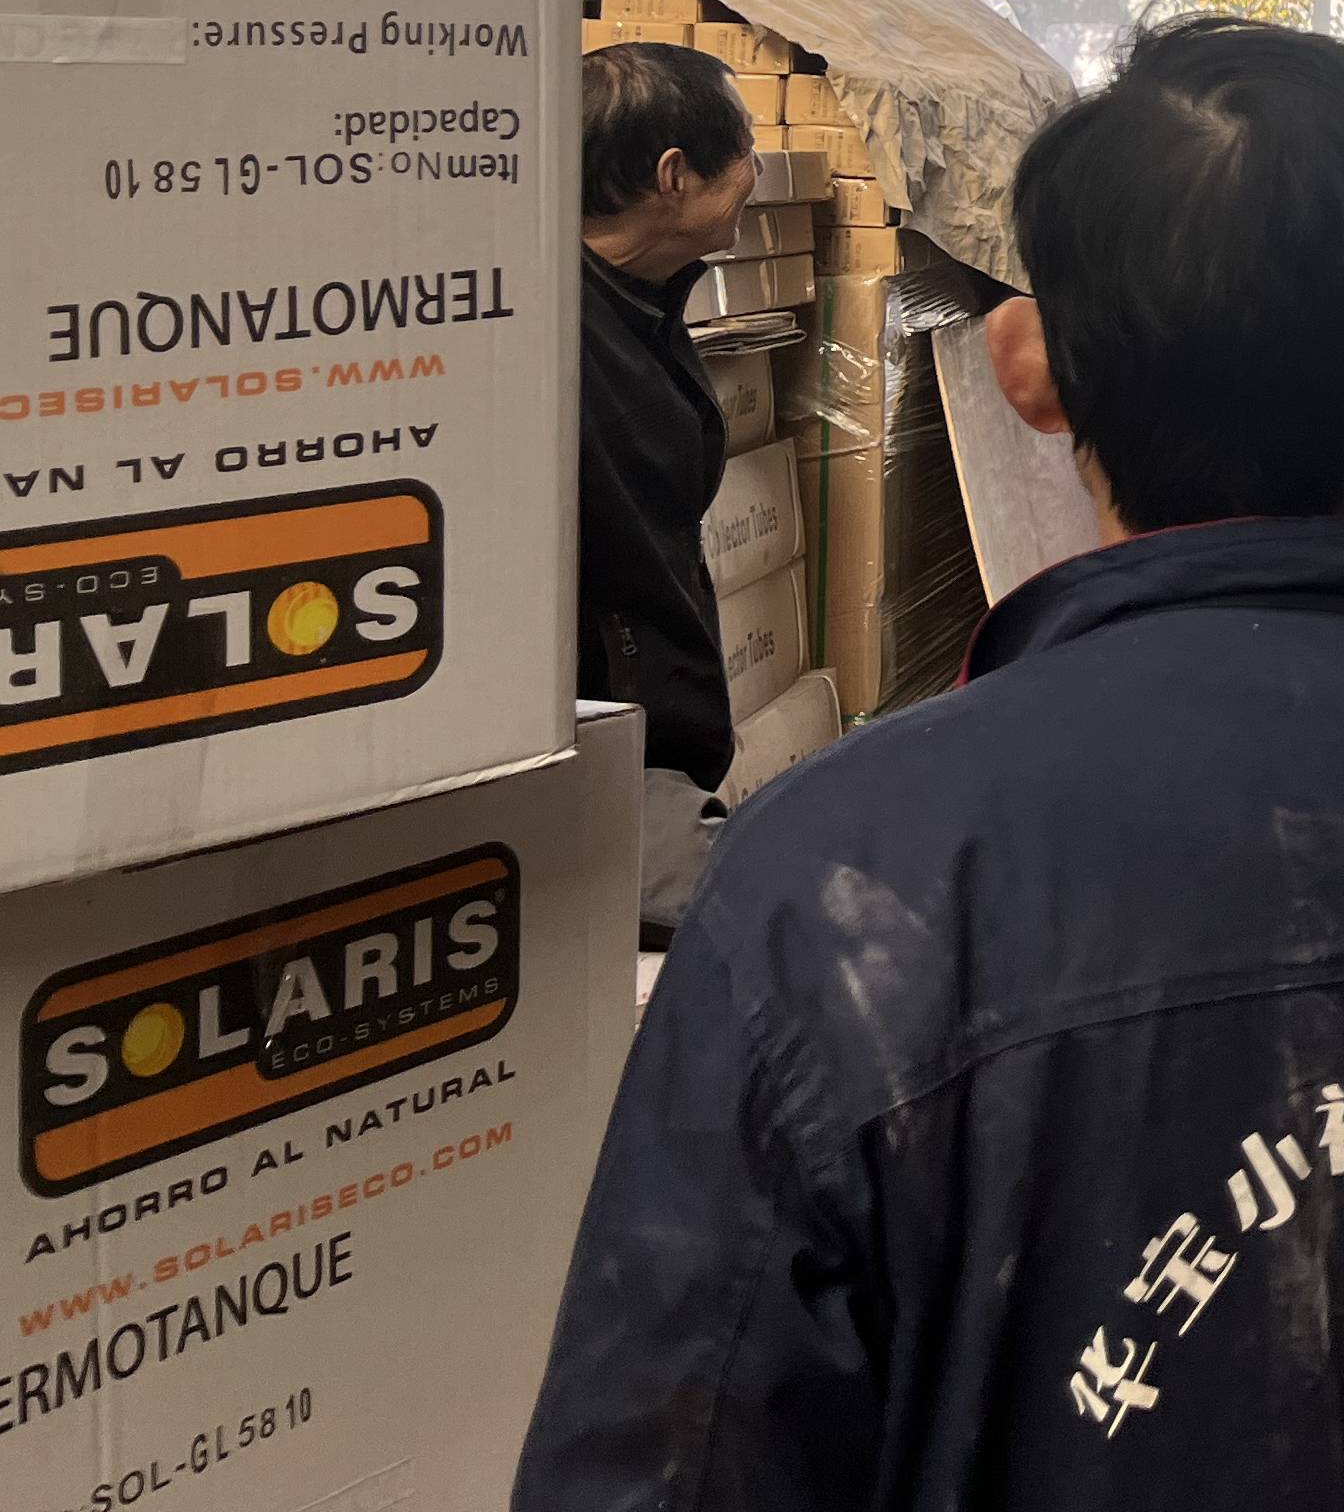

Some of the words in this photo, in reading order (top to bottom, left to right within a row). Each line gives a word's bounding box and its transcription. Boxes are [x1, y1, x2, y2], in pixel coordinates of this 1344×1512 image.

[193, 21, 367, 53] Pressure:
[382, 12, 528, 56] Working
[335, 101, 519, 140] Capacidad:
[47, 267, 513, 362] TERMOTANQUE
[116, 453, 184, 483] AL
[216, 423, 438, 472] AHORRO
[751, 504, 778, 539] Tubes
[44, 900, 499, 1108] SOLARIS
[273, 977, 499, 1071] ECO-SYSTEMS
[25, 1168, 228, 1262] AHORRO
[251, 1141, 303, 1176] AL
[326, 1061, 516, 1148] NATURAL
